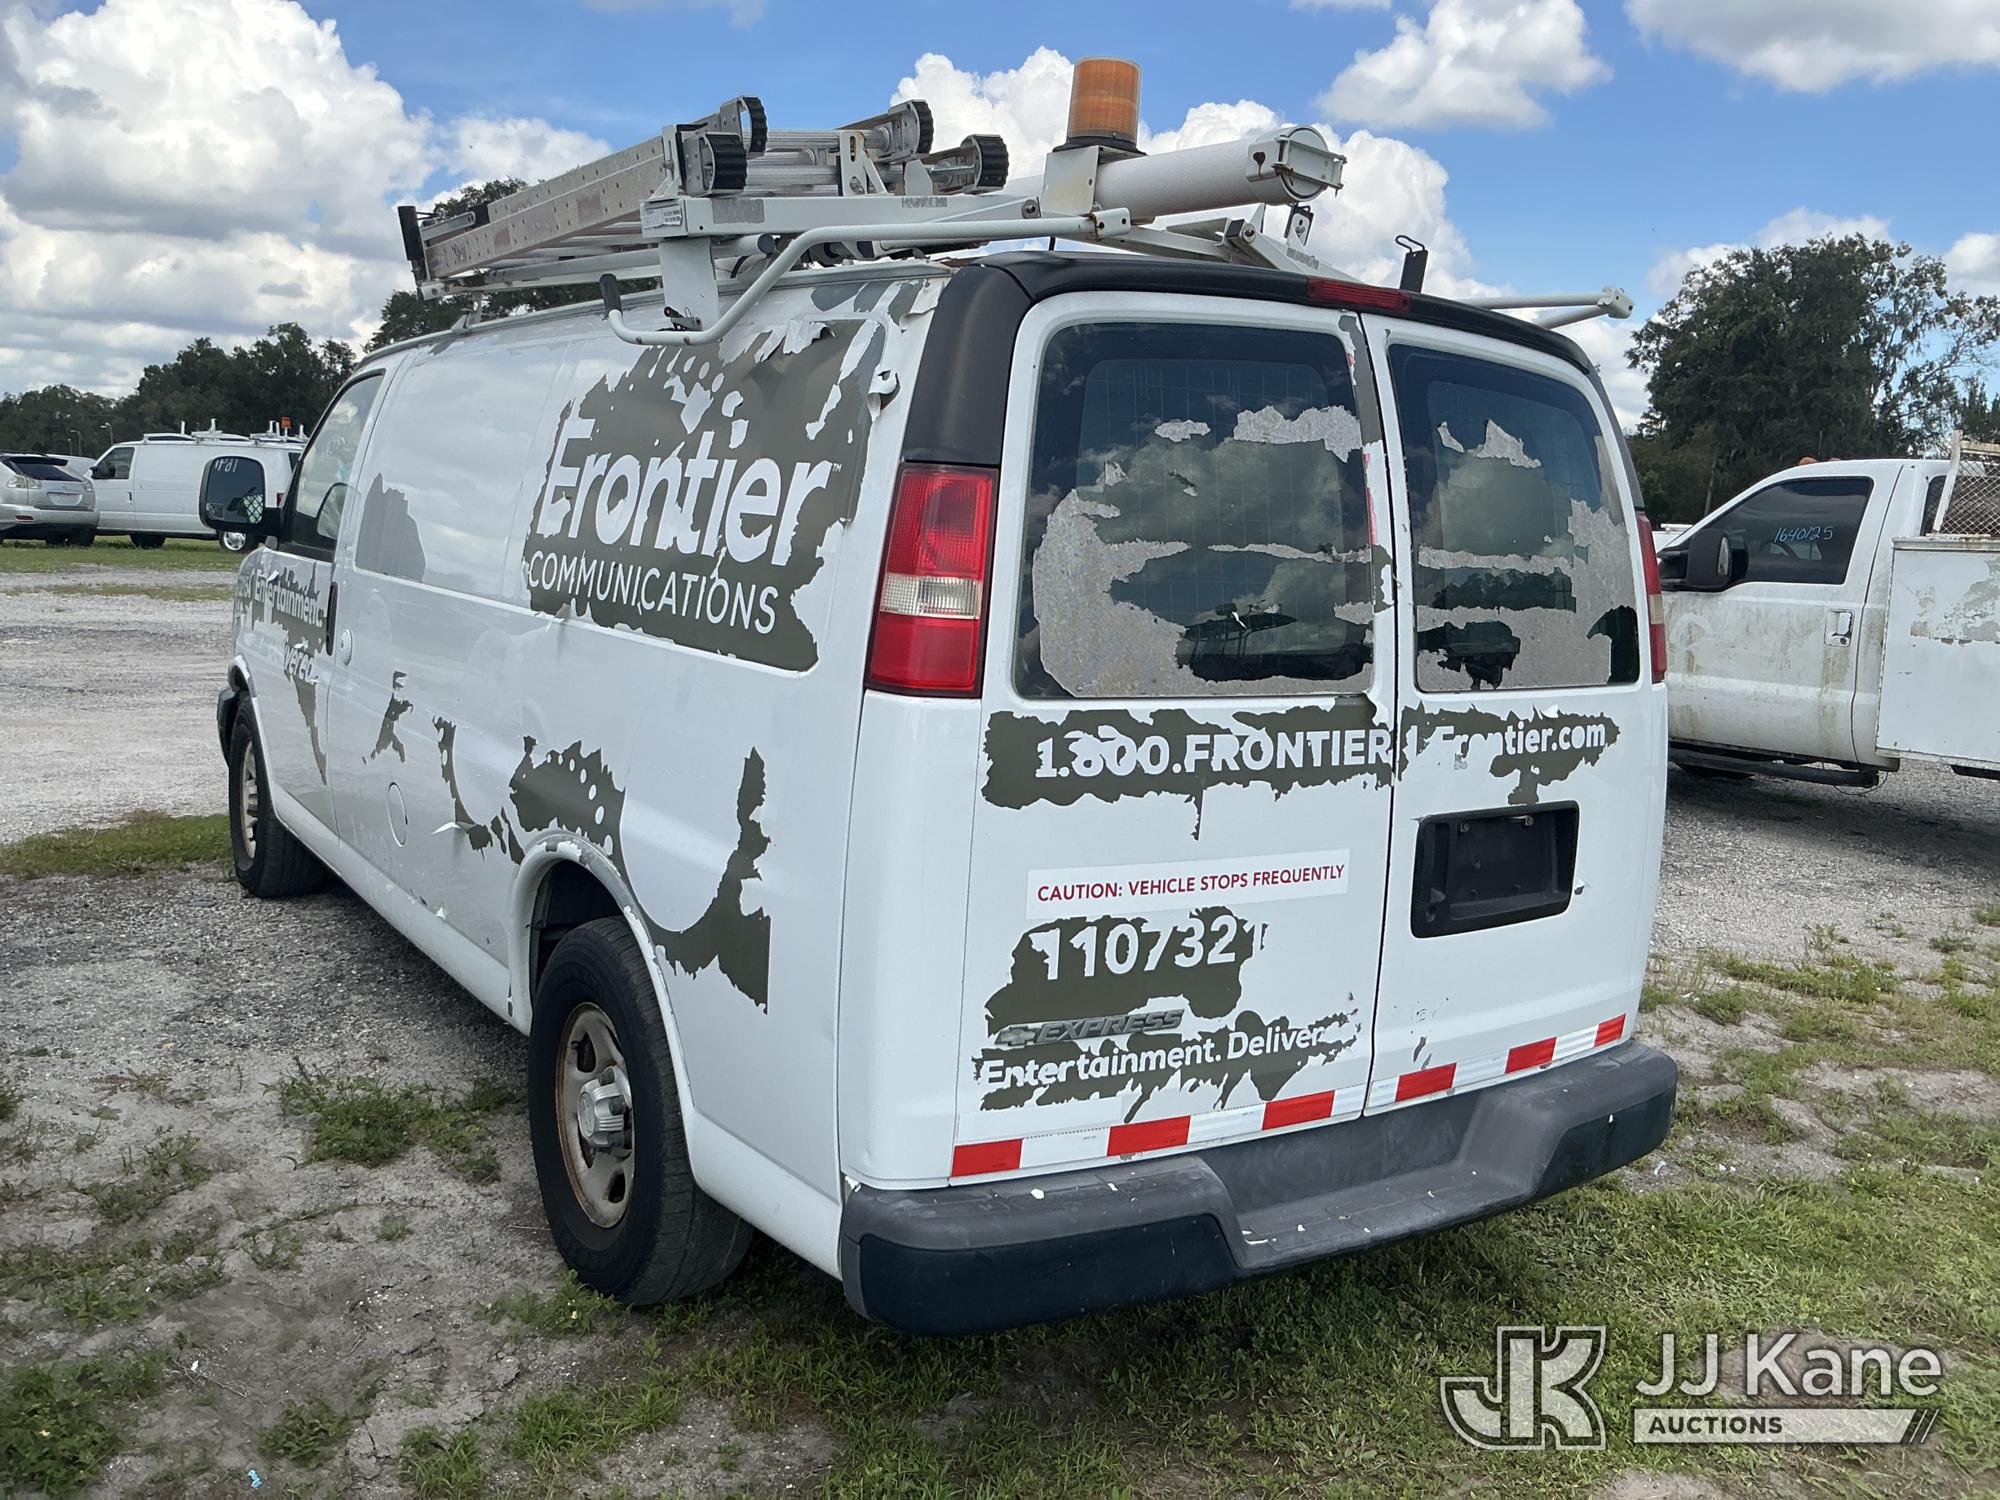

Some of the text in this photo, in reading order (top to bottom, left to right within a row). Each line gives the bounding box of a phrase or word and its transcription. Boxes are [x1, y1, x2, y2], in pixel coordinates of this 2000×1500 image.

[536, 418, 832, 567] Frontier
[1774, 526, 1834, 543] 1640125
[529, 550, 779, 635] COMMUNICATIONS
[1037, 864, 1345, 902] CAUTION: VEHICLE STOPS FREQUENTLY
[1036, 1009, 1185, 1044] EXPRESS
[978, 1037, 1222, 1089] Entertainment.
